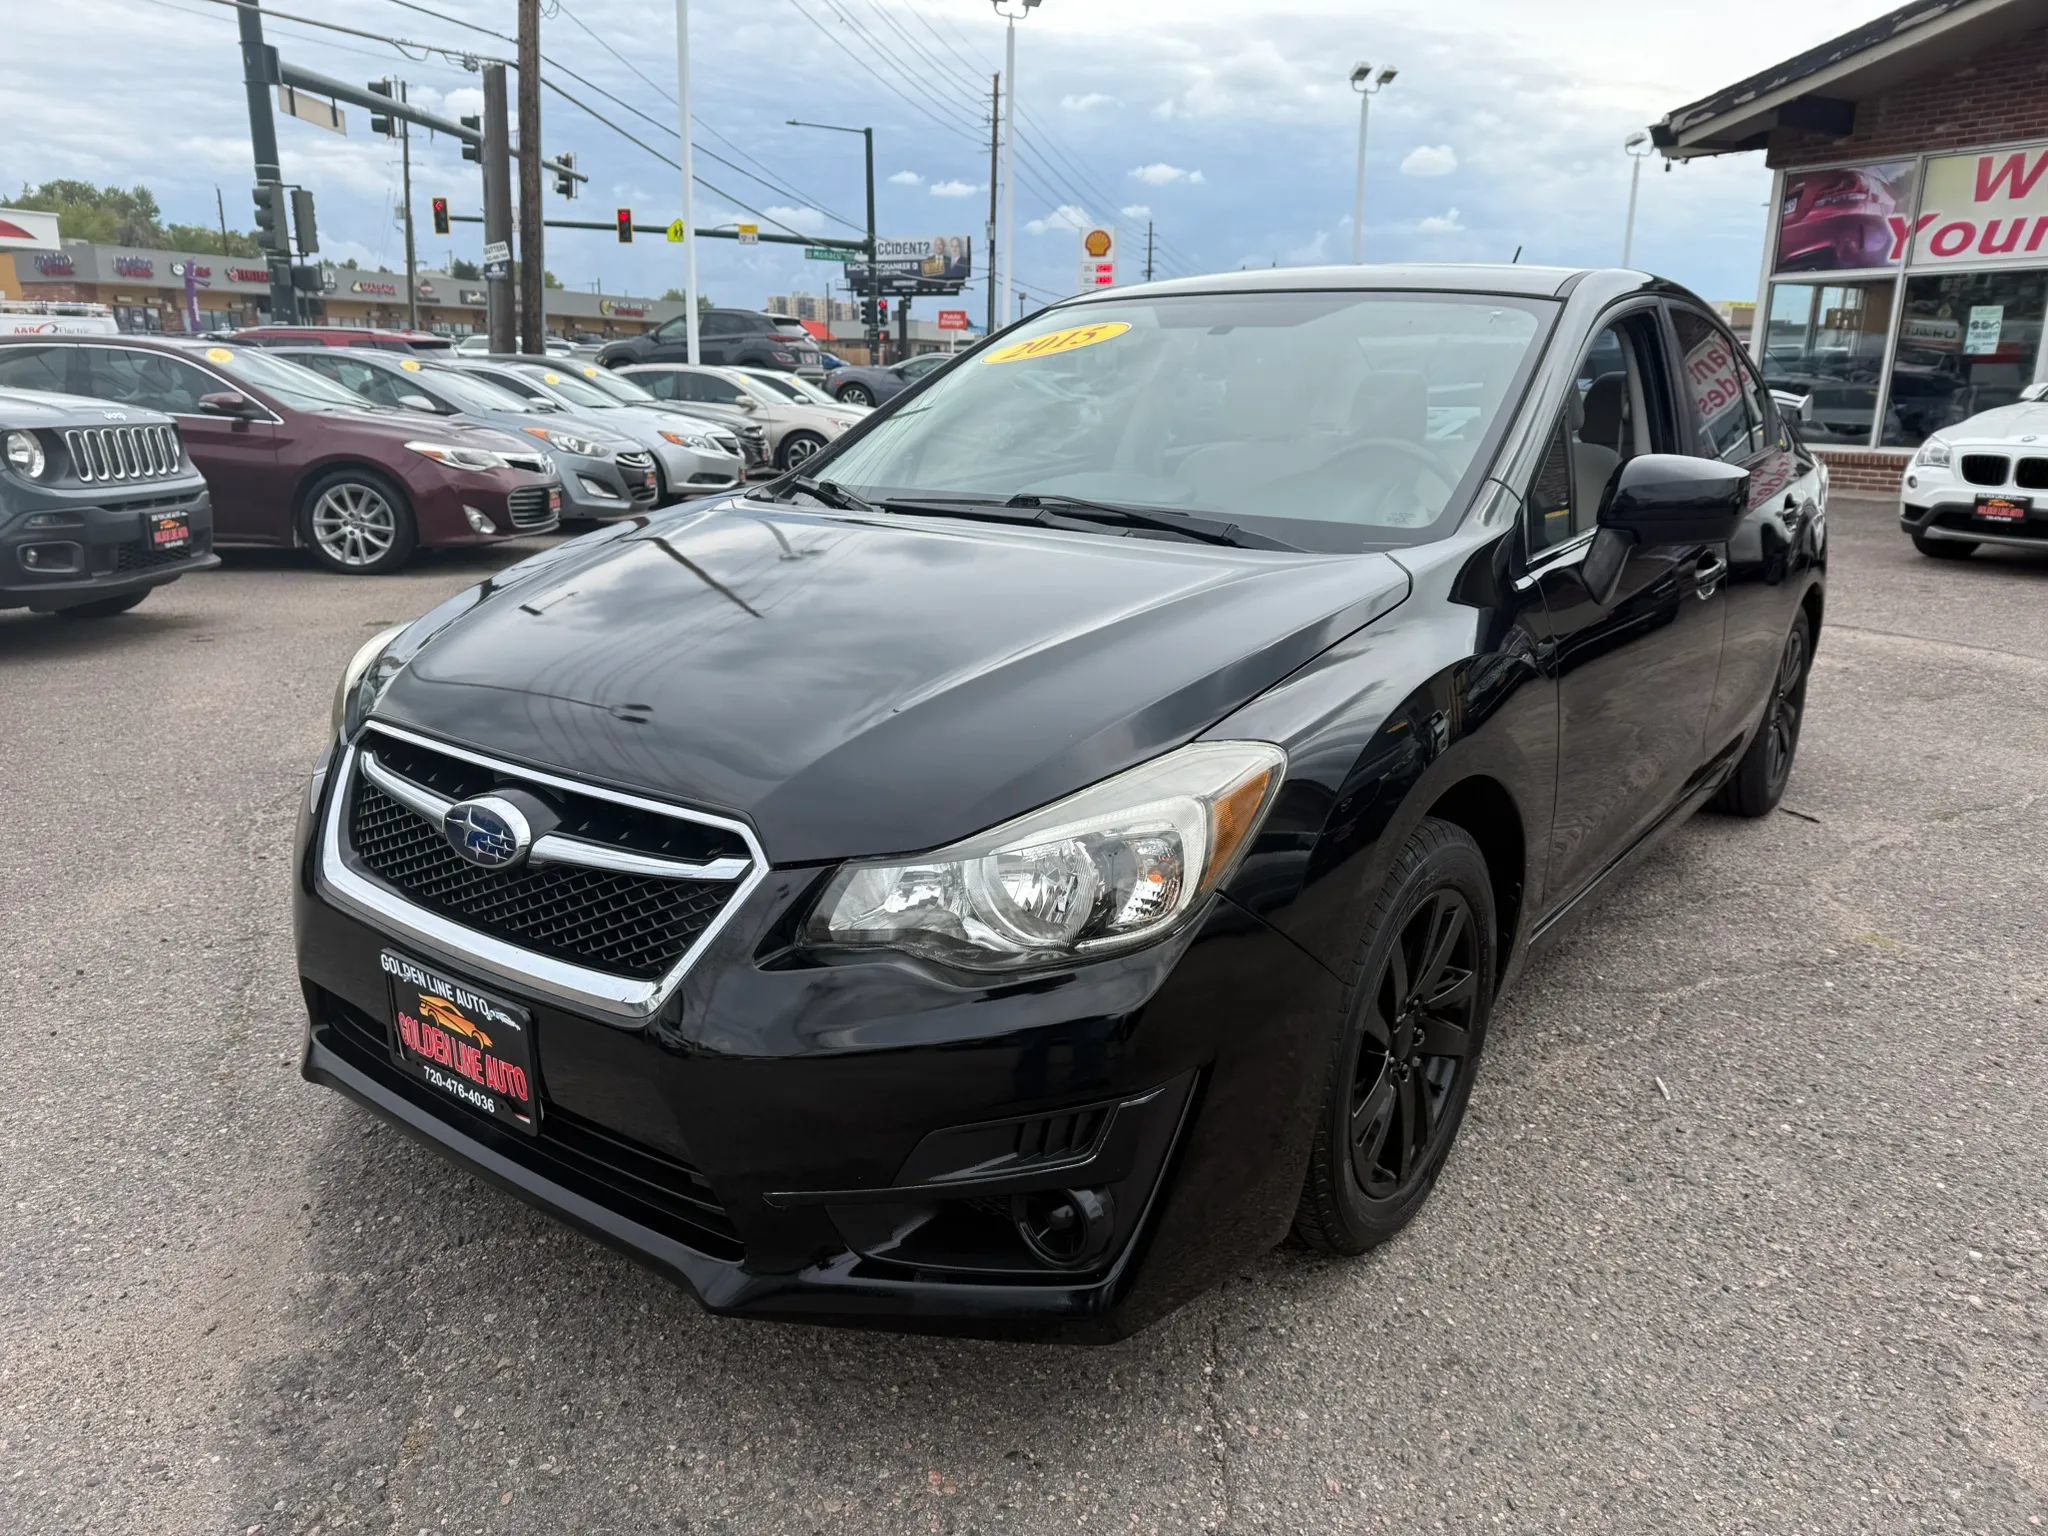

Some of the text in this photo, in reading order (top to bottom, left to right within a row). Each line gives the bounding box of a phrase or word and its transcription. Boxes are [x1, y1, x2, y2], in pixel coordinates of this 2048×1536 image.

[876, 241, 930, 255] CCIDENT?
[1000, 325, 1108, 361] 2015
[380, 953, 489, 1017] GOLDEN LINE AUTO
[398, 1011, 529, 1102] GOLDEN LINE AUTO
[423, 1065, 495, 1113] 720-476-4036
